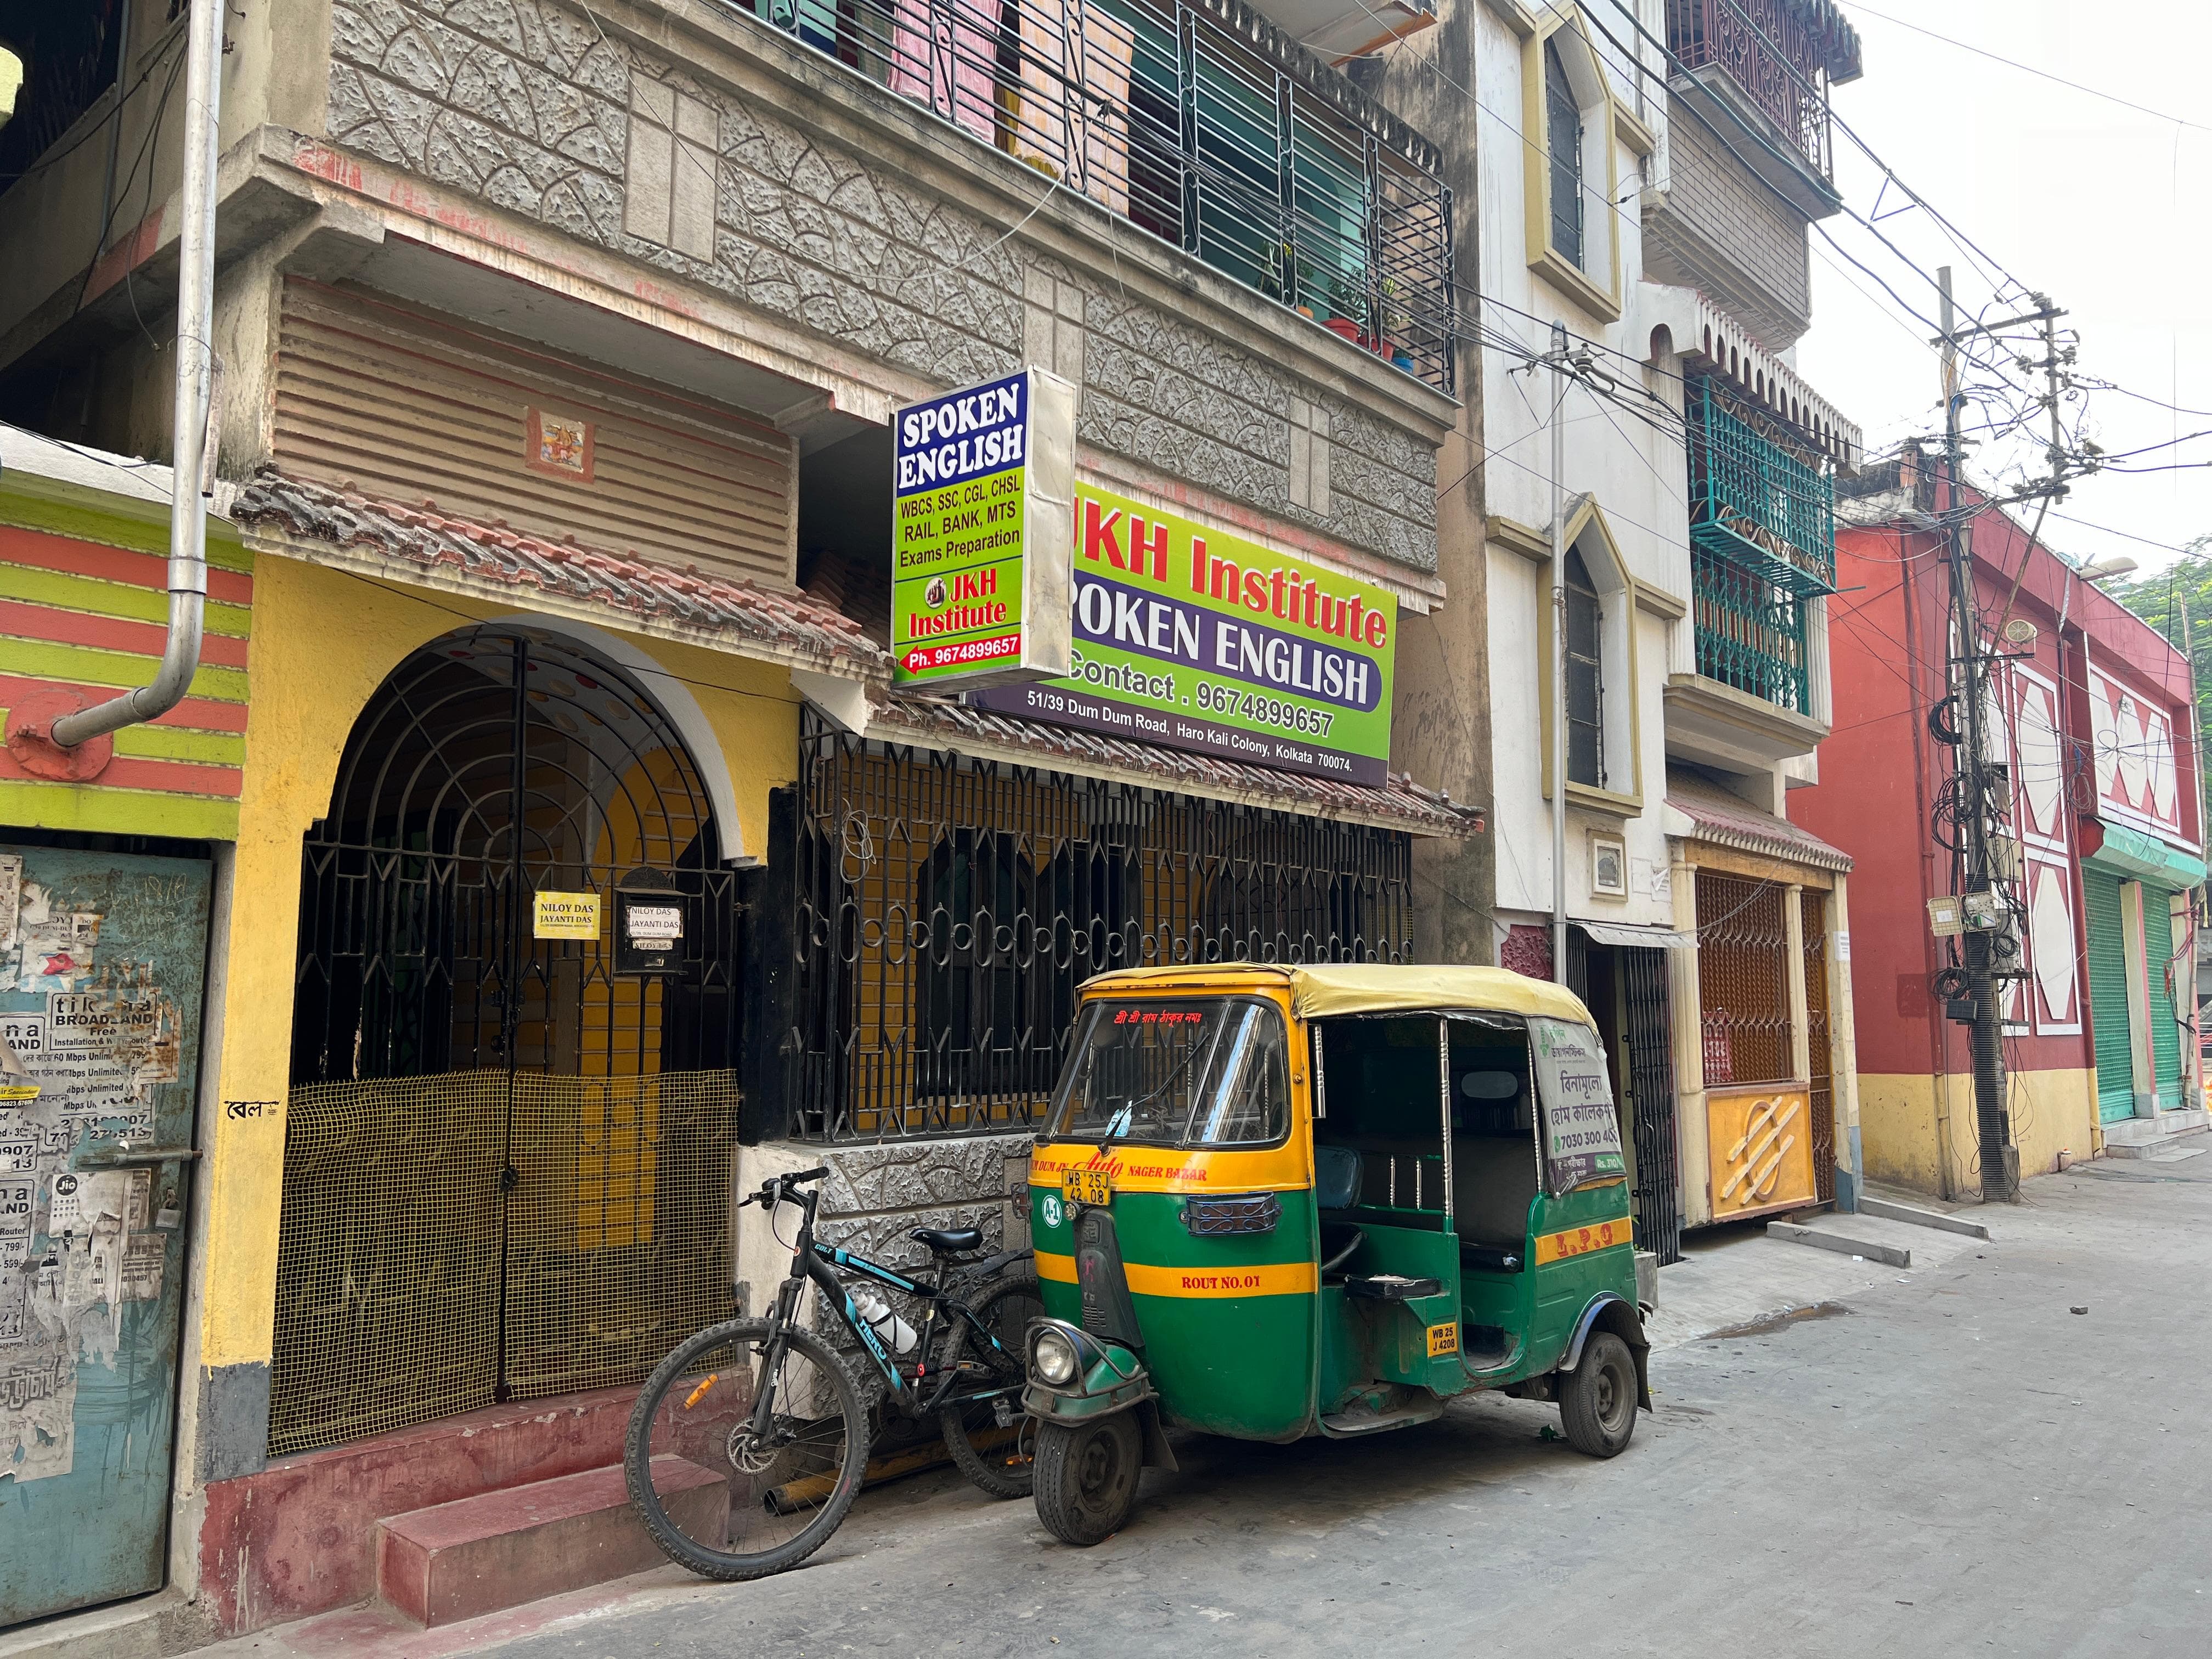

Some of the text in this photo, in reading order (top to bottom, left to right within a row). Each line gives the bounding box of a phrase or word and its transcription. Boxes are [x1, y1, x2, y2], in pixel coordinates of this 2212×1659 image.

[904, 383, 1019, 448] SPOKEN
[899, 424, 1023, 489] ENGLISH
[901, 474, 1020, 519] WBCS, SSC, CGL, CHSL
[905, 500, 1016, 543] RAIL, BANK, MTS
[900, 528, 1020, 568] Exams Preparation
[1074, 495, 1387, 649] KH Institute
[950, 568, 997, 603] JKH
[909, 600, 1007, 639] Institute
[1073, 580, 1368, 704] OKEN ENGLISH
[909, 636, 1018, 669] Ph. 9674899657
[1070, 648, 1174, 702] Contact
[1197, 680, 1334, 738] 9674899657
[1027, 689, 1353, 772] 51/39 Dum Dum Road, Haro Kali Colony, Kolkata 700074.
[541, 904, 594, 913] NILOY DAS
[55, 1014, 153, 1026] BROADAND
[1114, 1009, 1202, 1028] শ্রী শ্রী রাম ঠাকুর নমঃ
[90, 1027, 117, 1036] Free
[54, 1038, 97, 1046] Installation
[66, 1052, 87, 1063] Mbps
[224, 1100, 276, 1120] বেল
[1551, 1105, 1570, 1126] হোম
[1561, 1132, 1583, 1150] 7030
[1584, 1130, 1601, 1146] 300
[1039, 1161, 1056, 1172] DUM
[1073, 1151, 1124, 1179] Auto
[1128, 1165, 1163, 1178] NAGER
[1166, 1167, 1207, 1182] BAZAR
[1596, 1159, 1606, 1168] Rs.
[59, 1180, 76, 1190] Jio
[1068, 1171, 1109, 1189] WB 25J
[1070, 1187, 1104, 1204] 42 08
[1045, 1199, 1059, 1221] A-1
[814, 1243, 833, 1254] COLT
[1182, 1275, 1260, 1289] ROUT NO. 01
[1432, 1327, 1453, 1340] WB 25
[1433, 1338, 1455, 1351] J 4208
